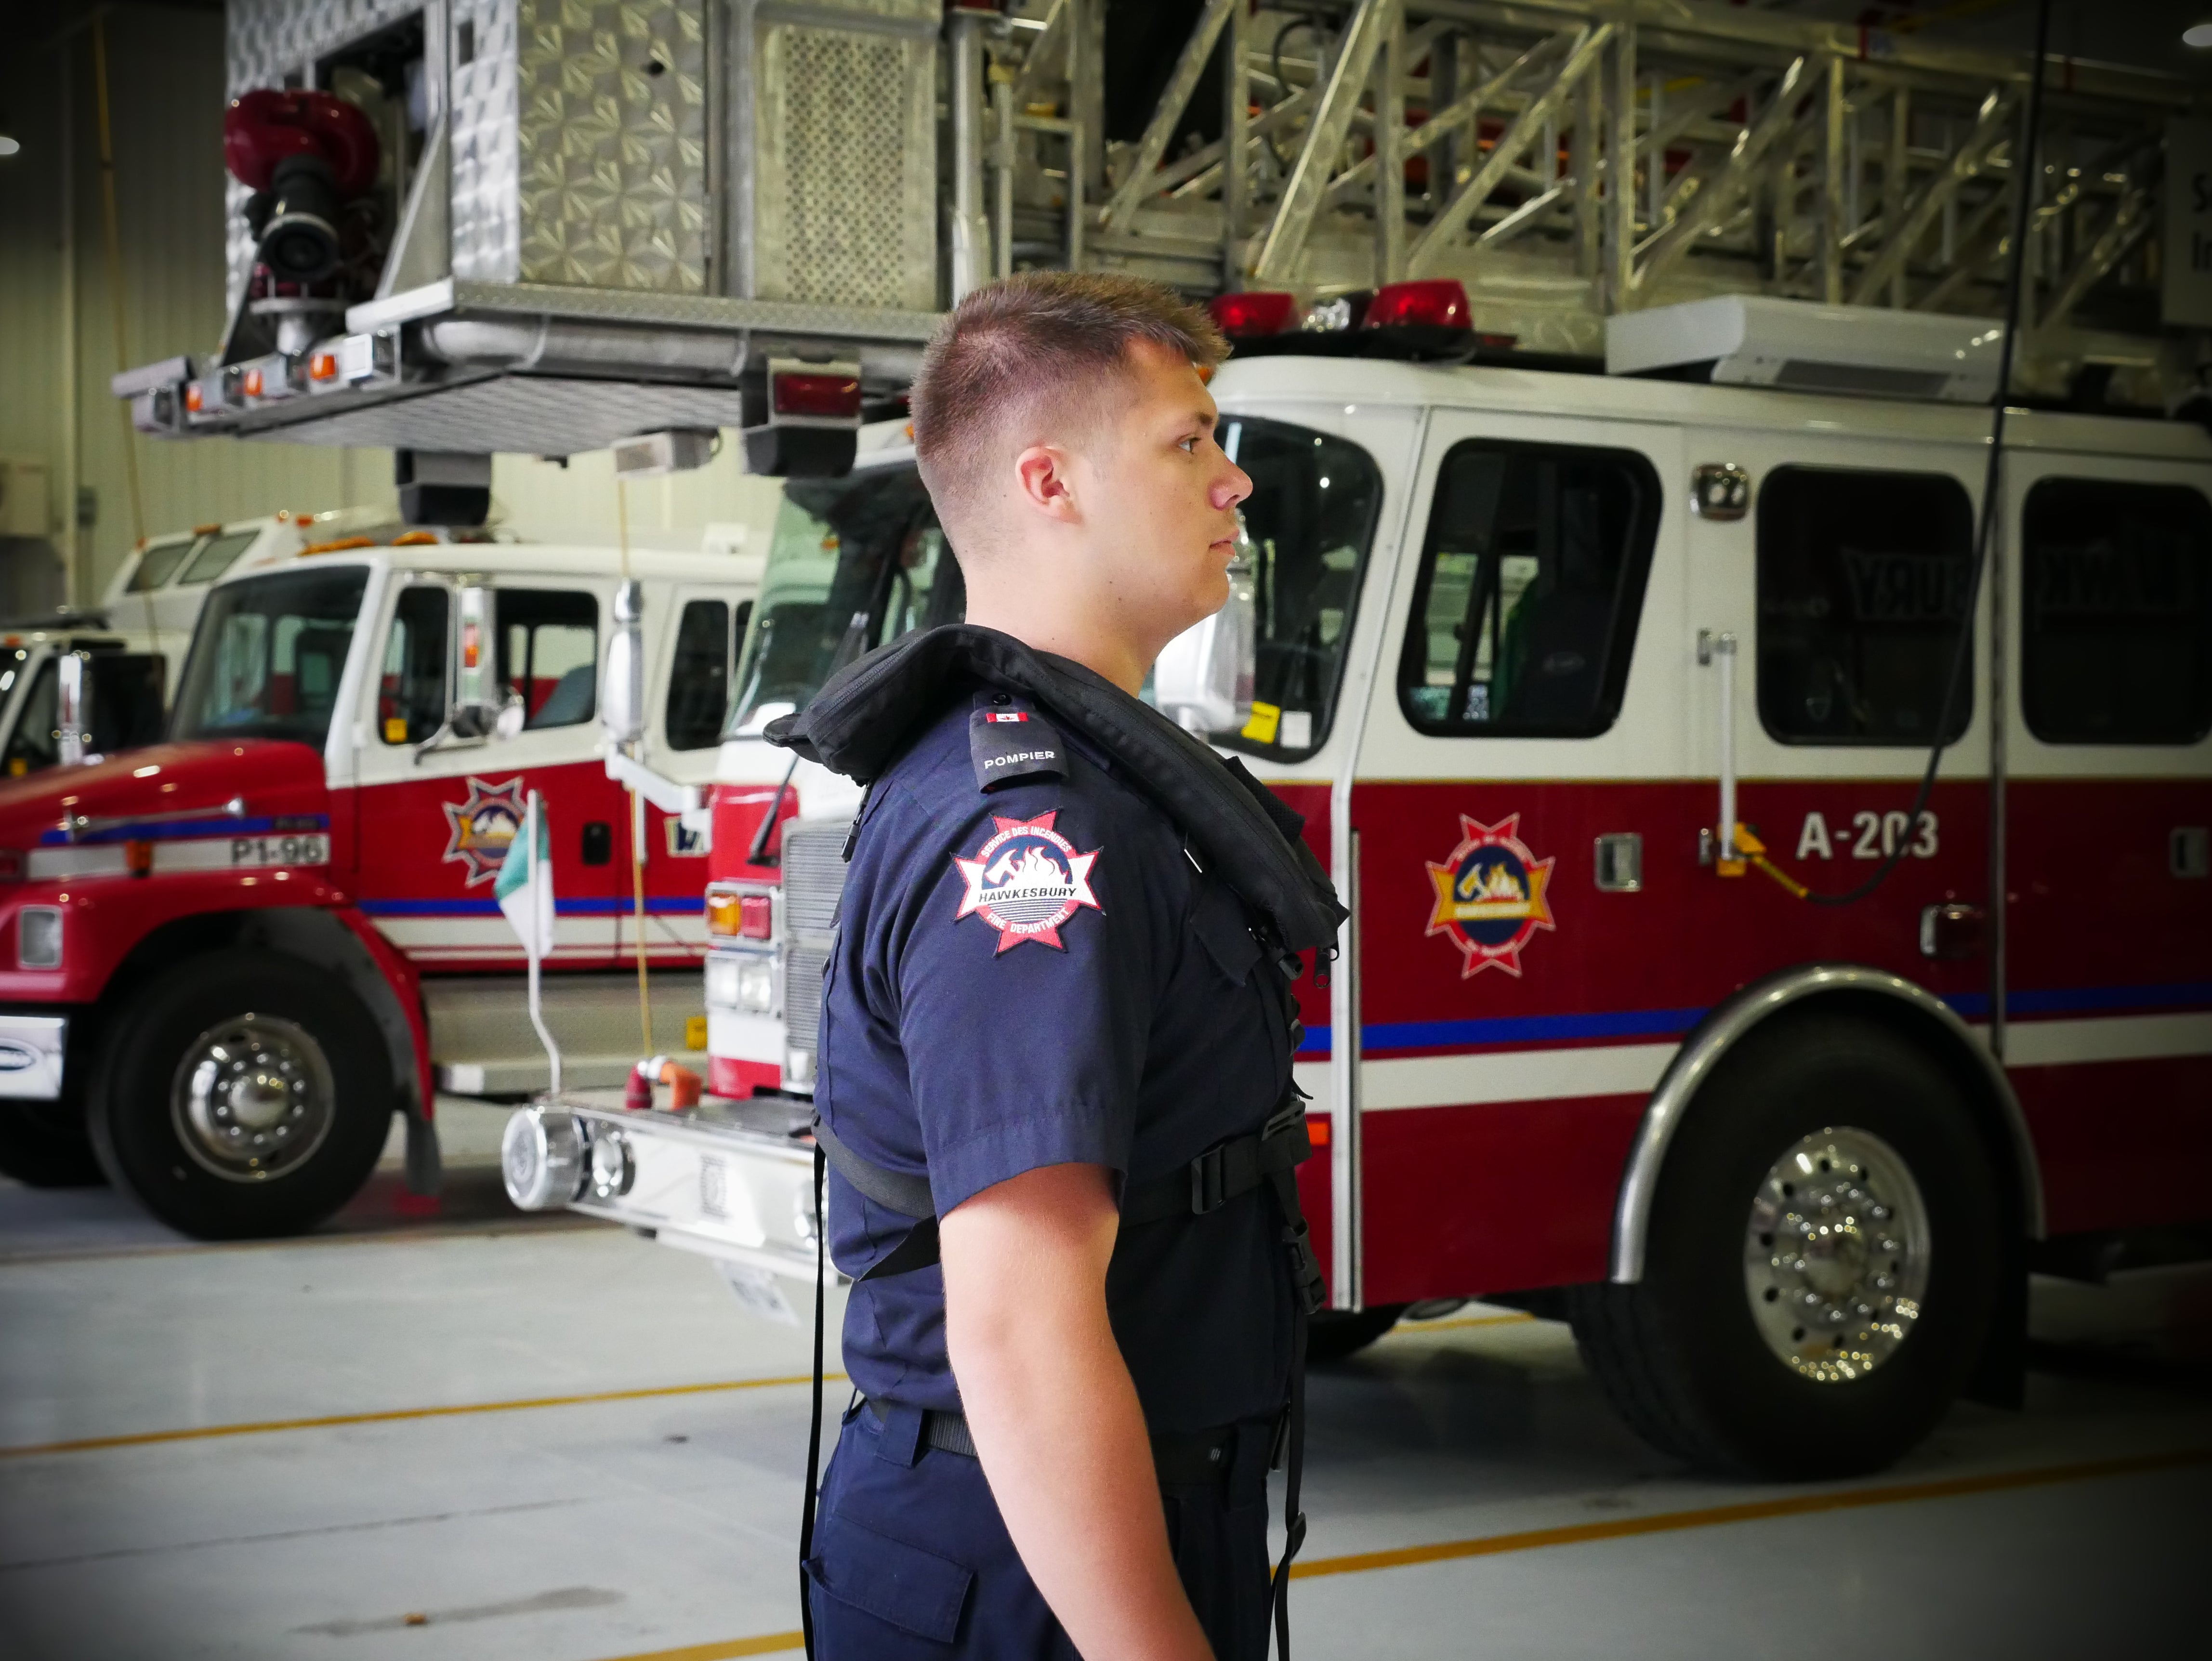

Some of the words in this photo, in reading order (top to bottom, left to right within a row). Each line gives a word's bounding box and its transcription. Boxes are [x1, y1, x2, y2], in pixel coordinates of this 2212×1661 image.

[984, 751, 1055, 769] POMPIER
[981, 830, 1011, 857] SERVICE
[1012, 827, 1028, 835] DES
[1030, 826, 1072, 852] INCENDIES
[1795, 810, 1939, 860] A-203
[232, 837, 322, 864] P1-96
[978, 887, 1077, 903] HAWKESBURY
[988, 912, 1007, 930] FIRE
[1010, 907, 1069, 934] DEPARTMENT
